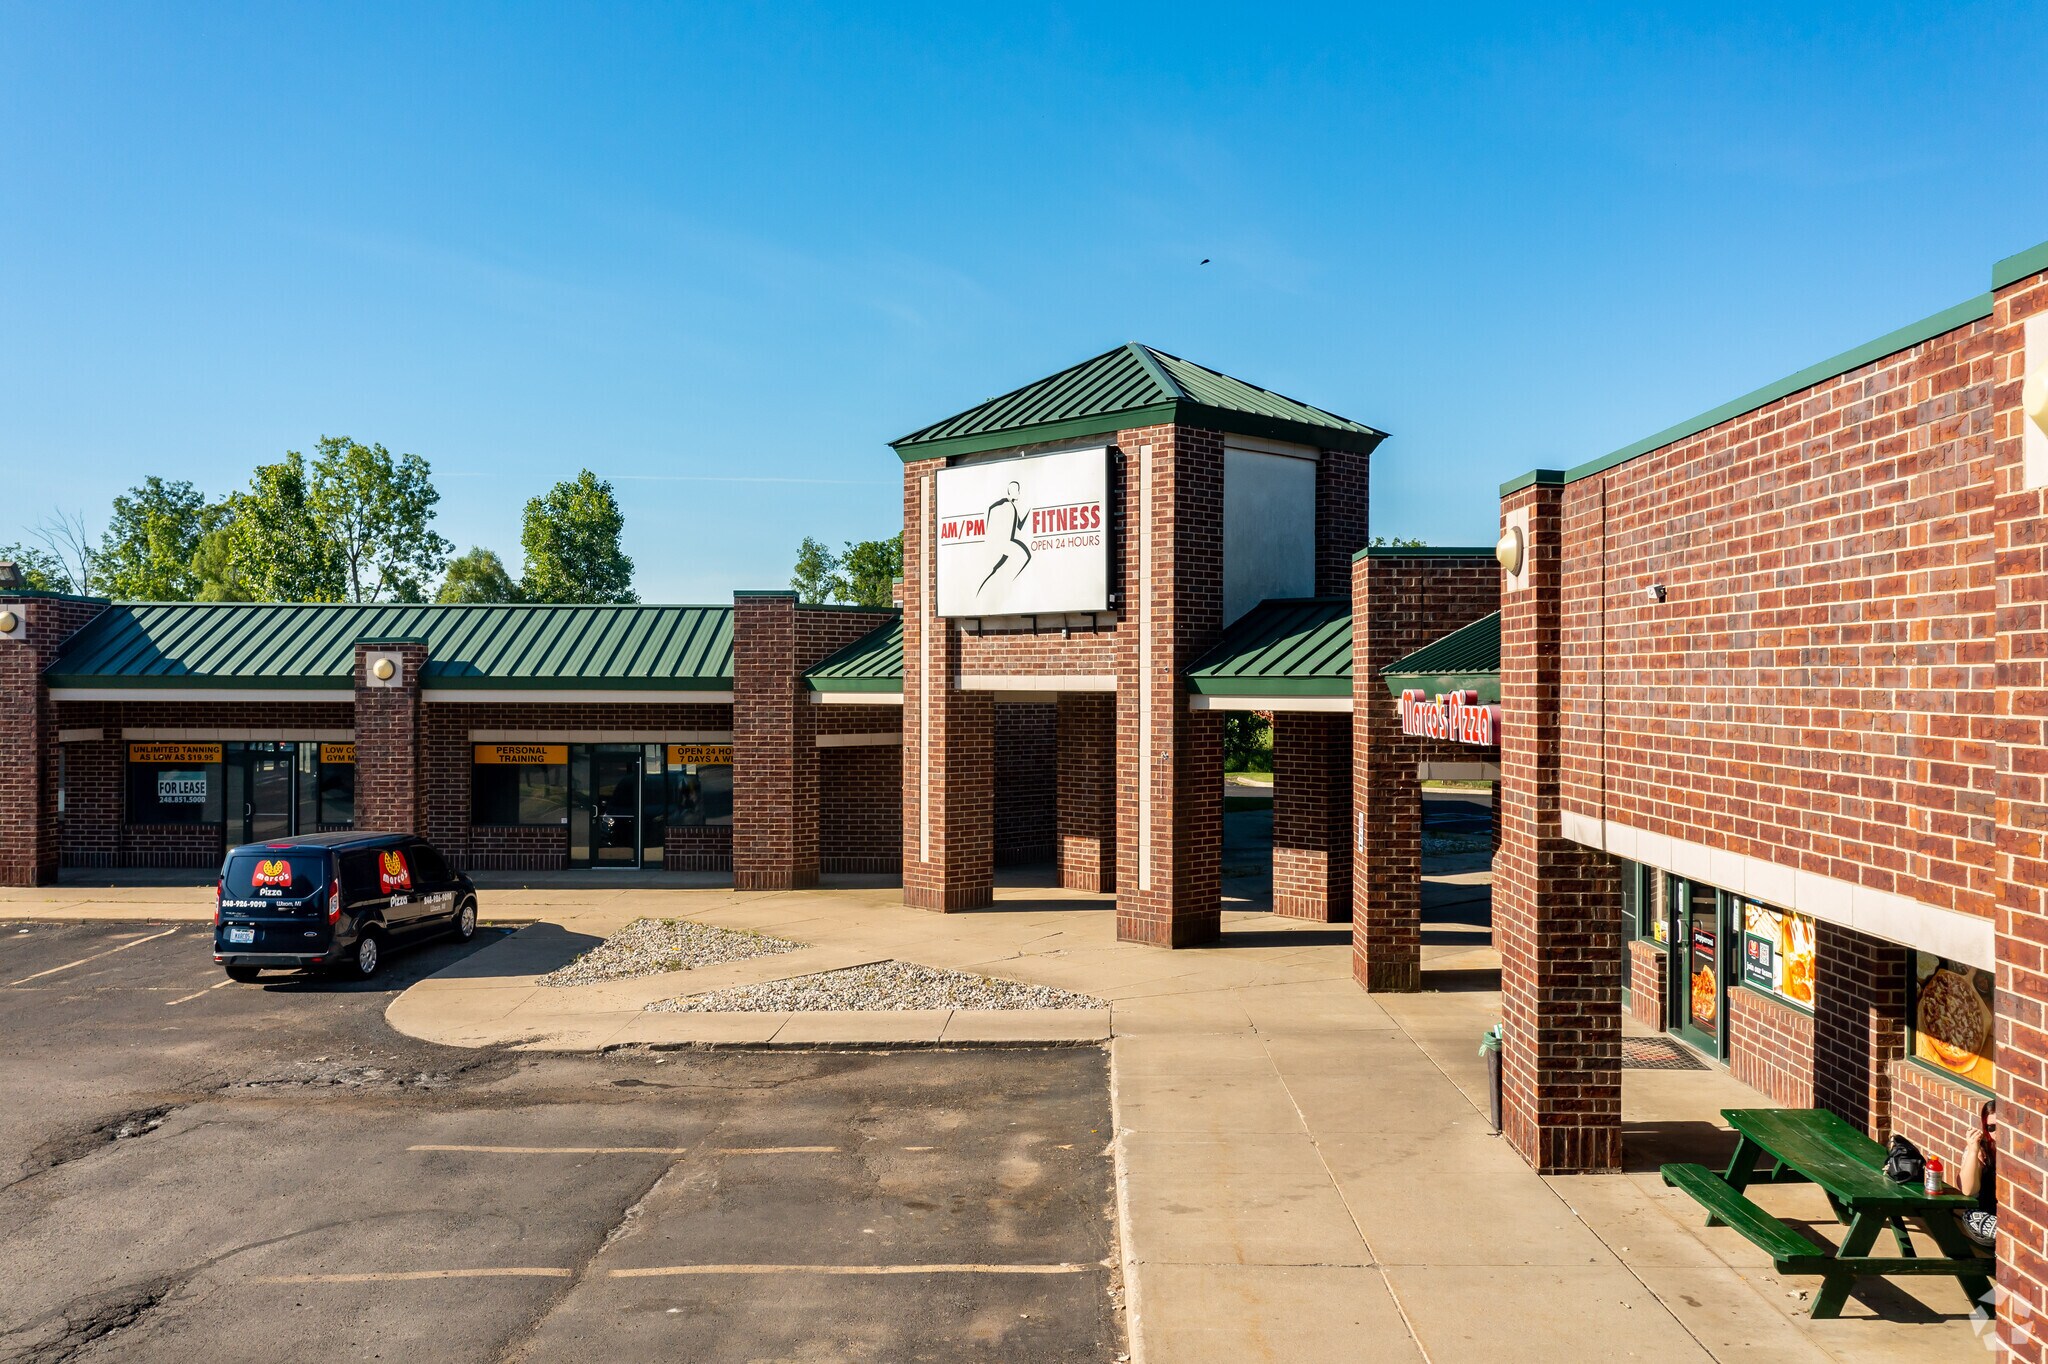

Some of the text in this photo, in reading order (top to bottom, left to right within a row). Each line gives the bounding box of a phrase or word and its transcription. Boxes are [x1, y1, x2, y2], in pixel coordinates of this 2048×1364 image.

[1032, 505, 1101, 534] FITNESS
[941, 519, 986, 540] AM/PM
[1031, 535, 1100, 551] OPEN 24 HOURS
[1449, 689, 1493, 746] Pizza
[496, 746, 547, 754] PERSONAL
[187, 753, 214, 761] $19.95
[159, 782, 206, 794] FOR LEASE
[259, 887, 282, 896] Pizza
[222, 900, 267, 908] 248-926-9090
[390, 893, 408, 908] Pizza
